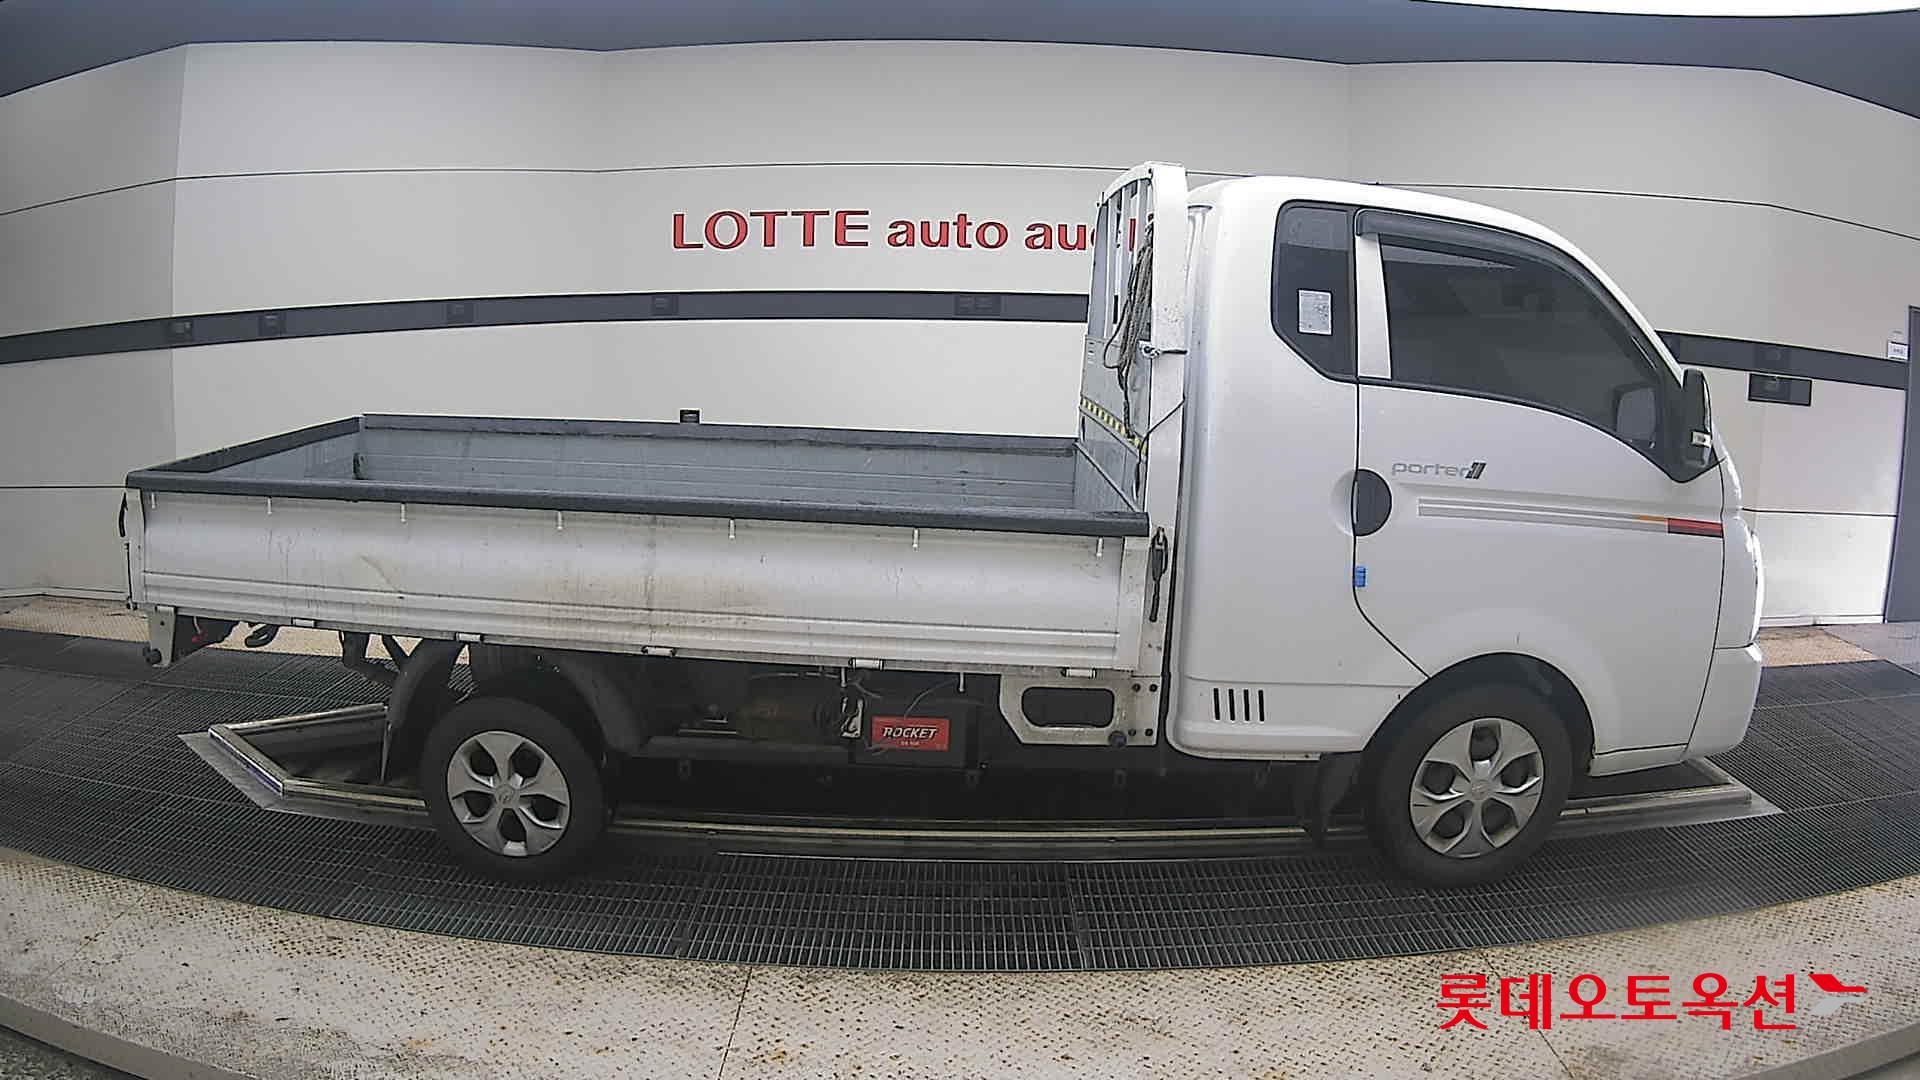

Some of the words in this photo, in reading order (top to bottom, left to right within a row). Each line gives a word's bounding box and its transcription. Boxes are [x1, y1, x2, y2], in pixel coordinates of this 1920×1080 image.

[673, 210, 869, 249] LOTTE
[887, 213, 1009, 249] auto
[883, 727, 938, 738] ROCKET
